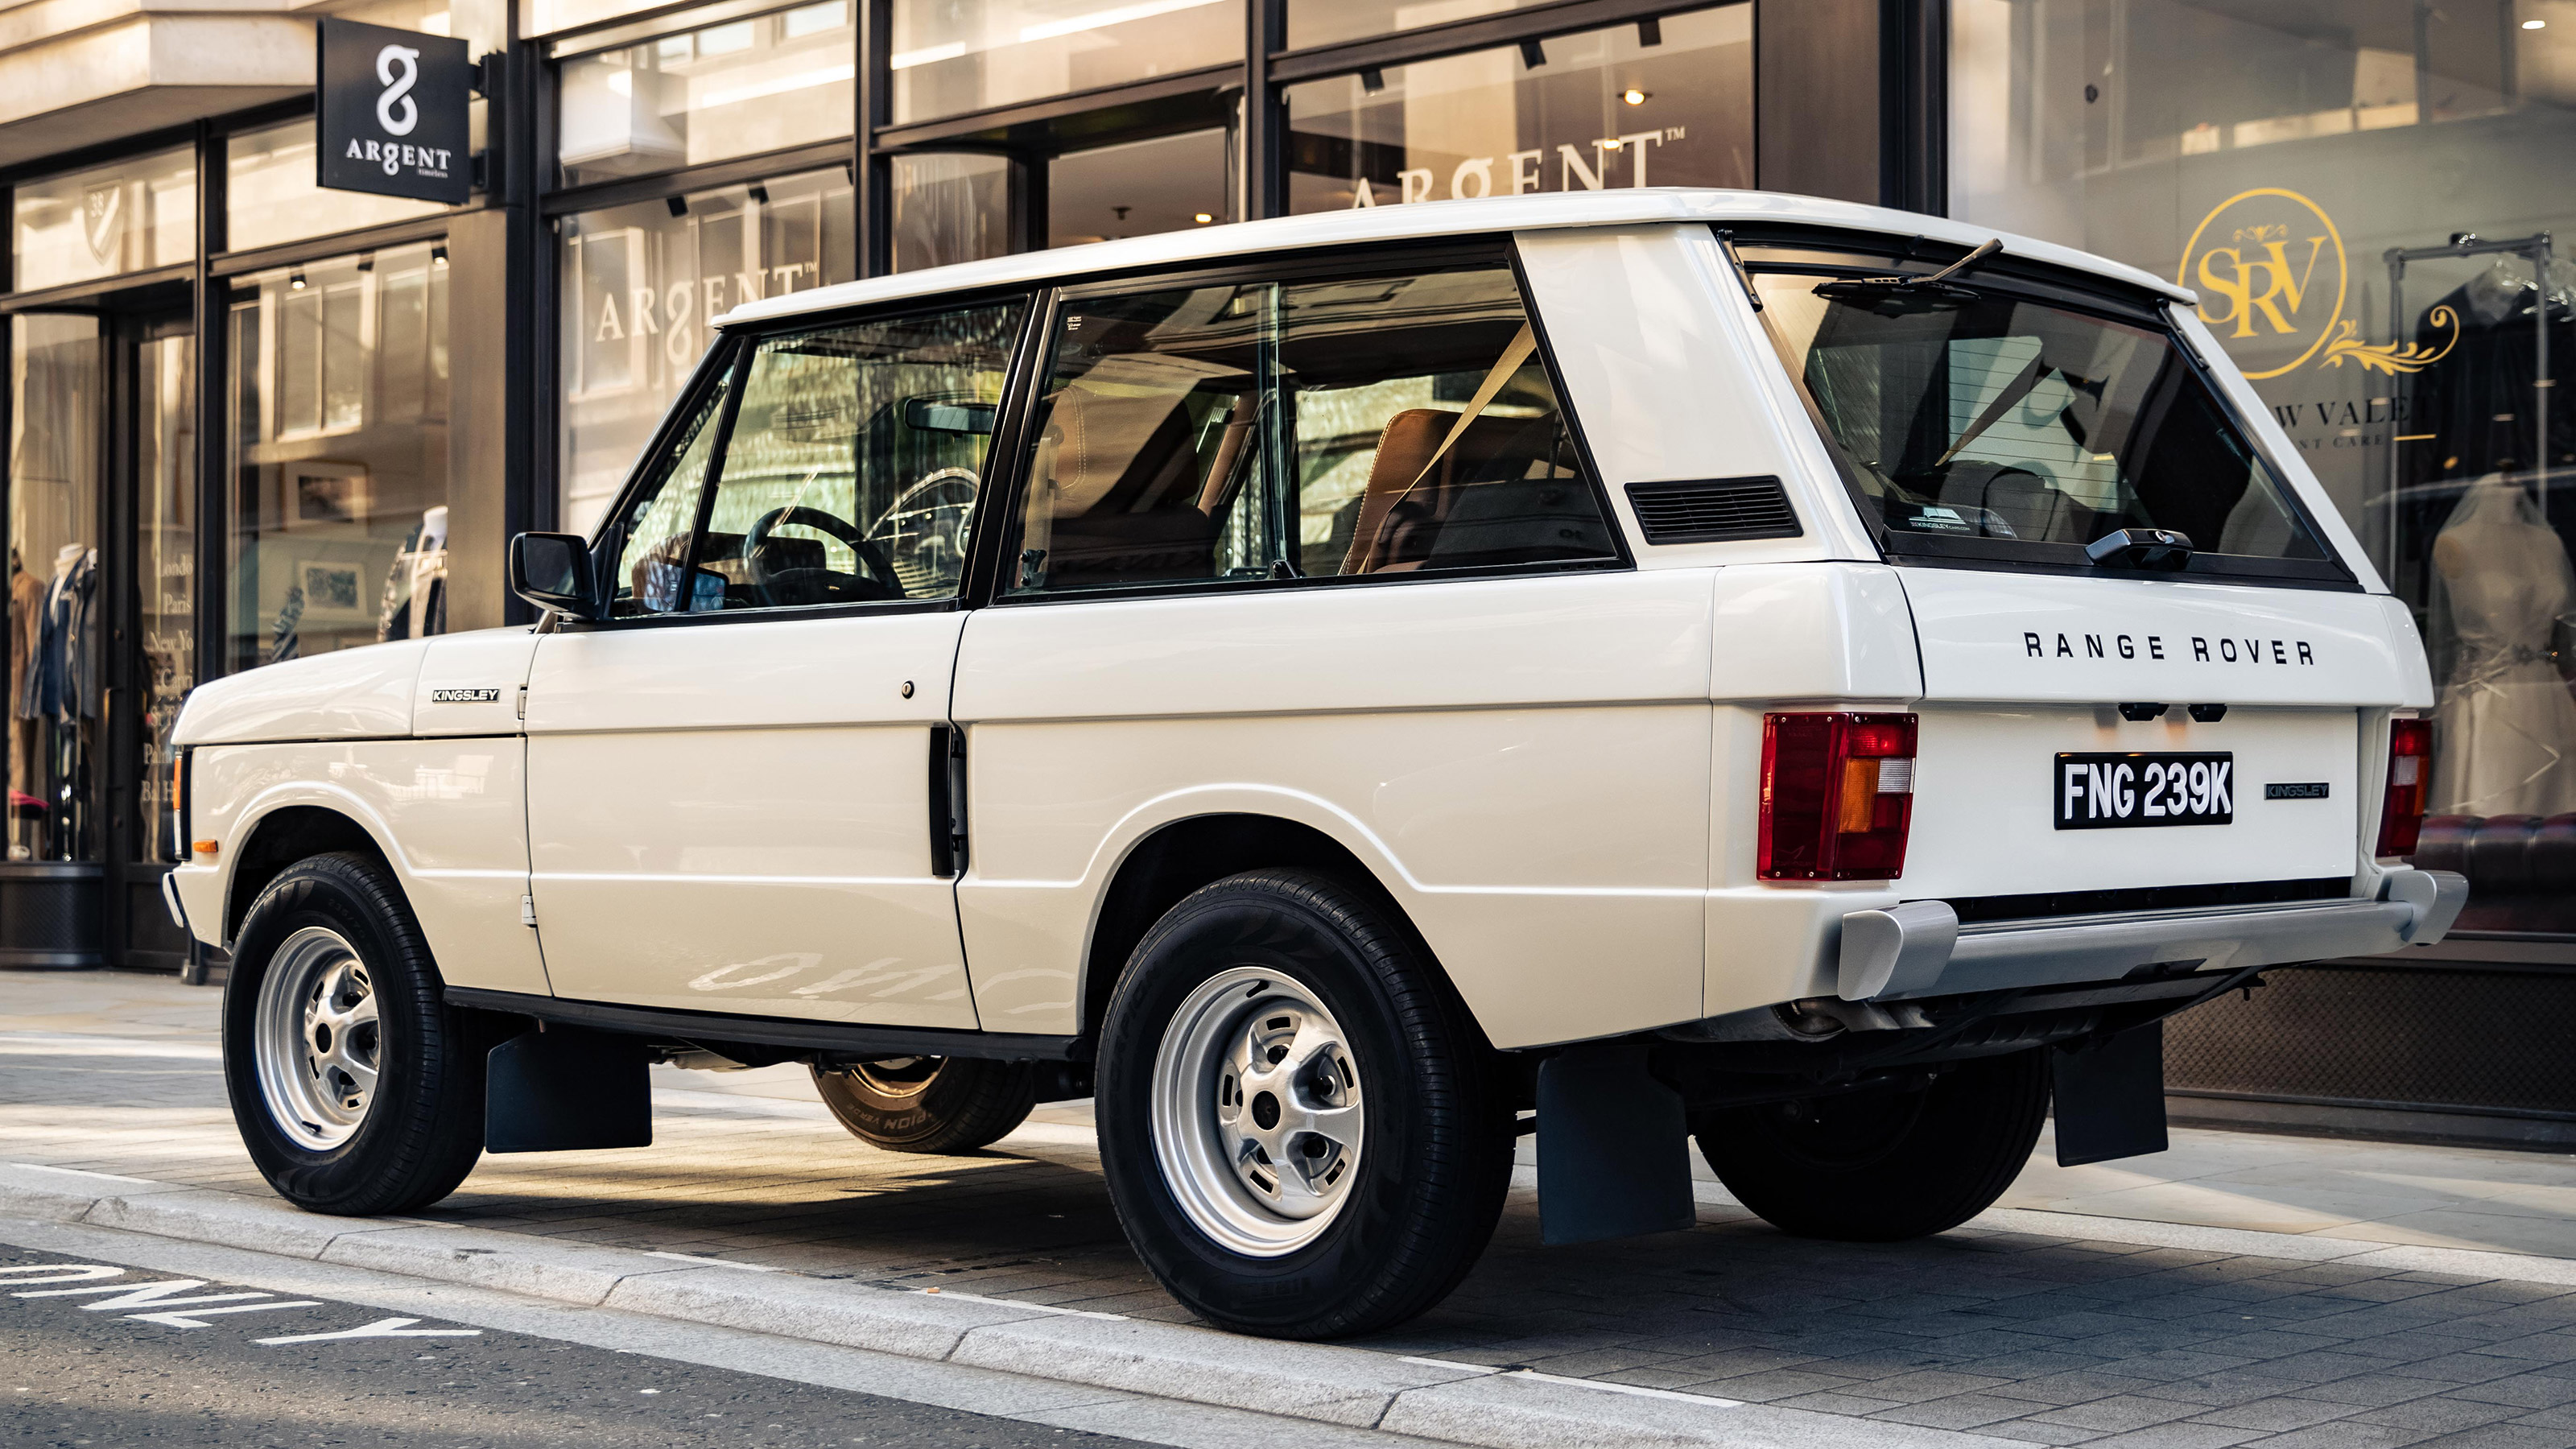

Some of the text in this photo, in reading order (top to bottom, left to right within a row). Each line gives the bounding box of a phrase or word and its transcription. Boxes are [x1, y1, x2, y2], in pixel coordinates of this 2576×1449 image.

[2198, 236, 2328, 338] SRV
[162, 593, 192, 615] Paris
[2024, 631, 2314, 666] RANGE ROVER
[433, 690, 497, 701] KINGSLEY
[2064, 761, 2231, 819] FNG 239K
[2267, 784, 2328, 797] KINGSLEY
